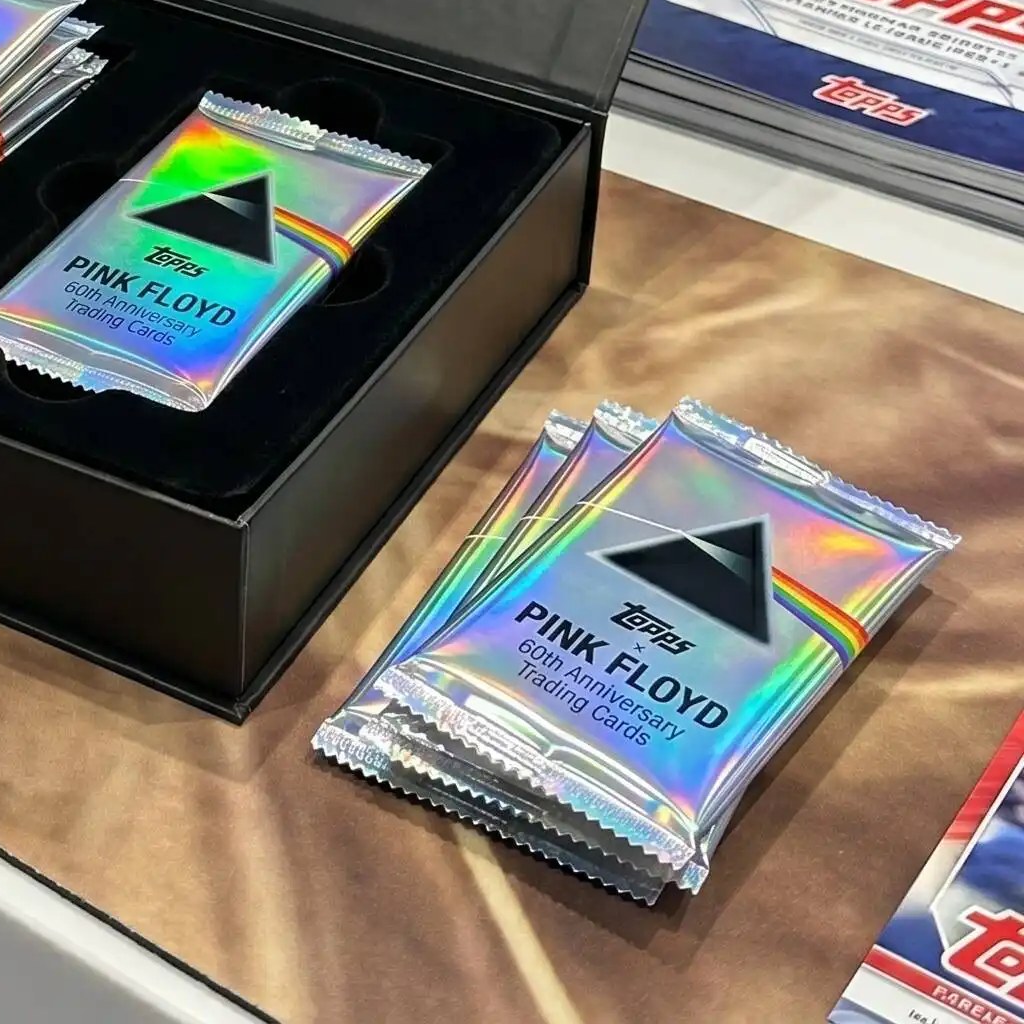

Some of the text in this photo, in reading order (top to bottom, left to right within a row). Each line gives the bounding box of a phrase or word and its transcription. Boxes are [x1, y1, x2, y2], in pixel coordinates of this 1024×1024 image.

[63, 255, 236, 326] PINK FLOYD
[64, 281, 202, 338] 60th Anniversary
[65, 298, 176, 346] Trading Cards
[514, 600, 729, 729] PINK FLOYD
[518, 638, 686, 741] 60th Anniversary
[518, 660, 651, 746] Trading Cards
